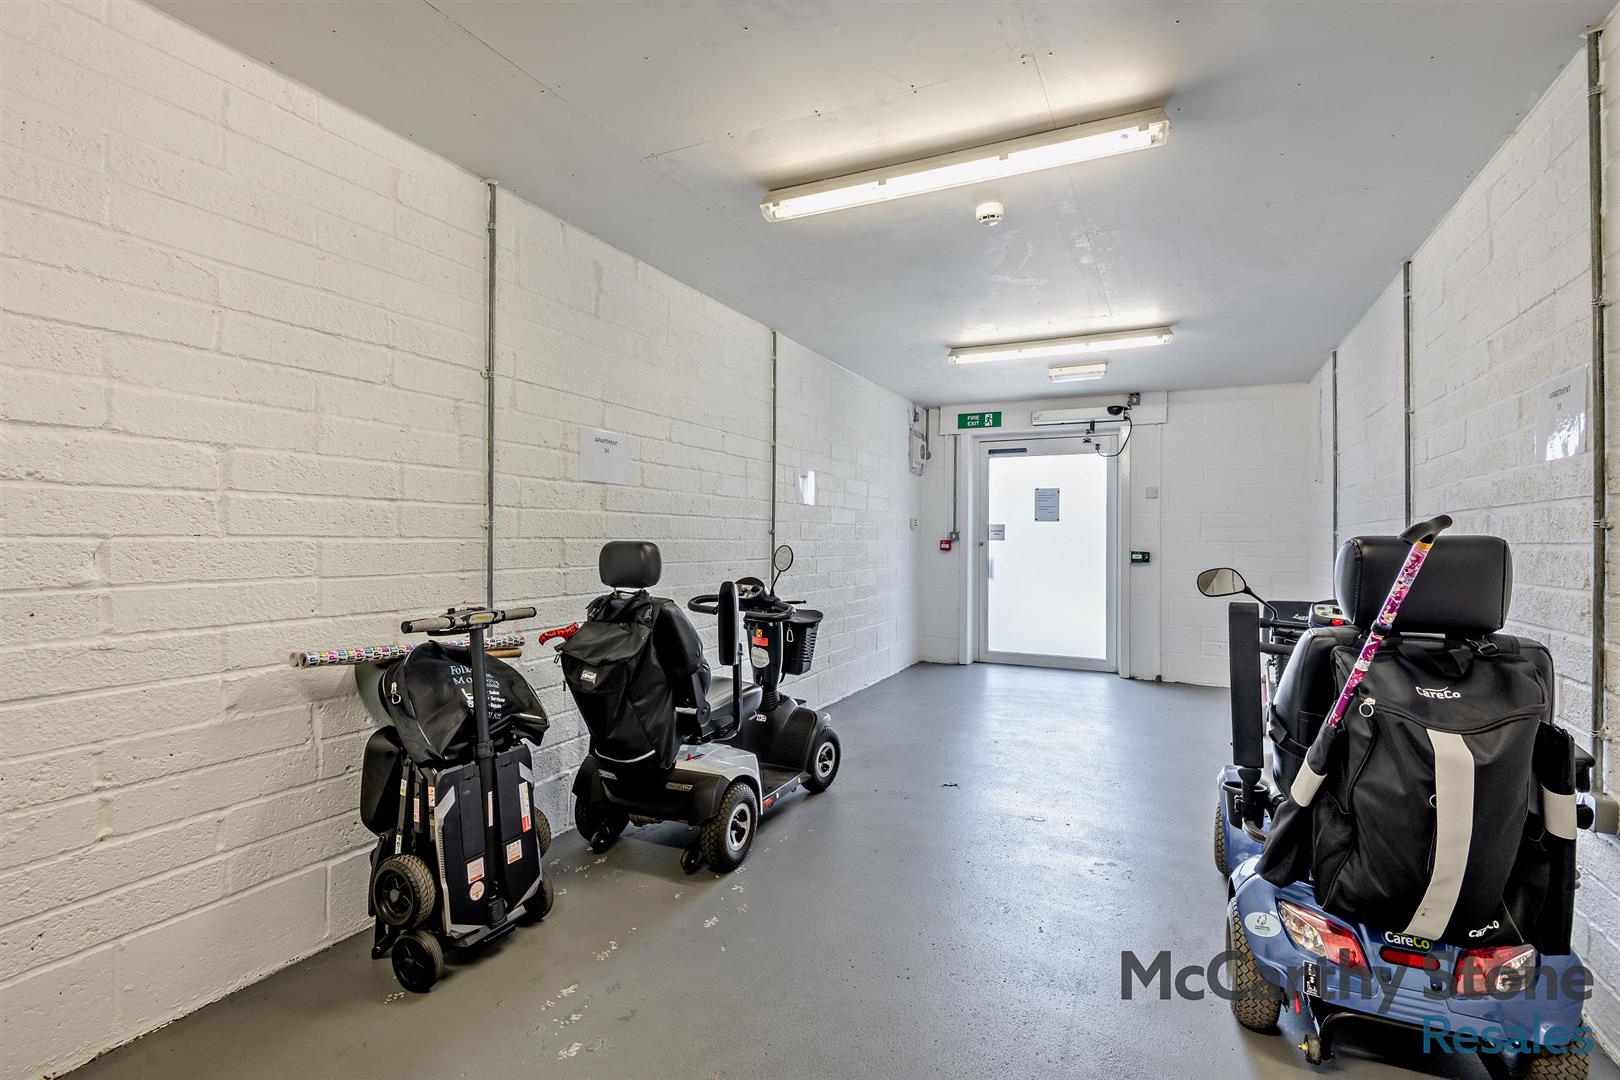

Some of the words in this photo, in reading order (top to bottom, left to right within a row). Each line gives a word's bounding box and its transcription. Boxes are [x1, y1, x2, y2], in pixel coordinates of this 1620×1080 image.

[449, 665, 472, 675] Folk
[1415, 686, 1461, 699] CareCo
[1384, 931, 1430, 949] CareCo
